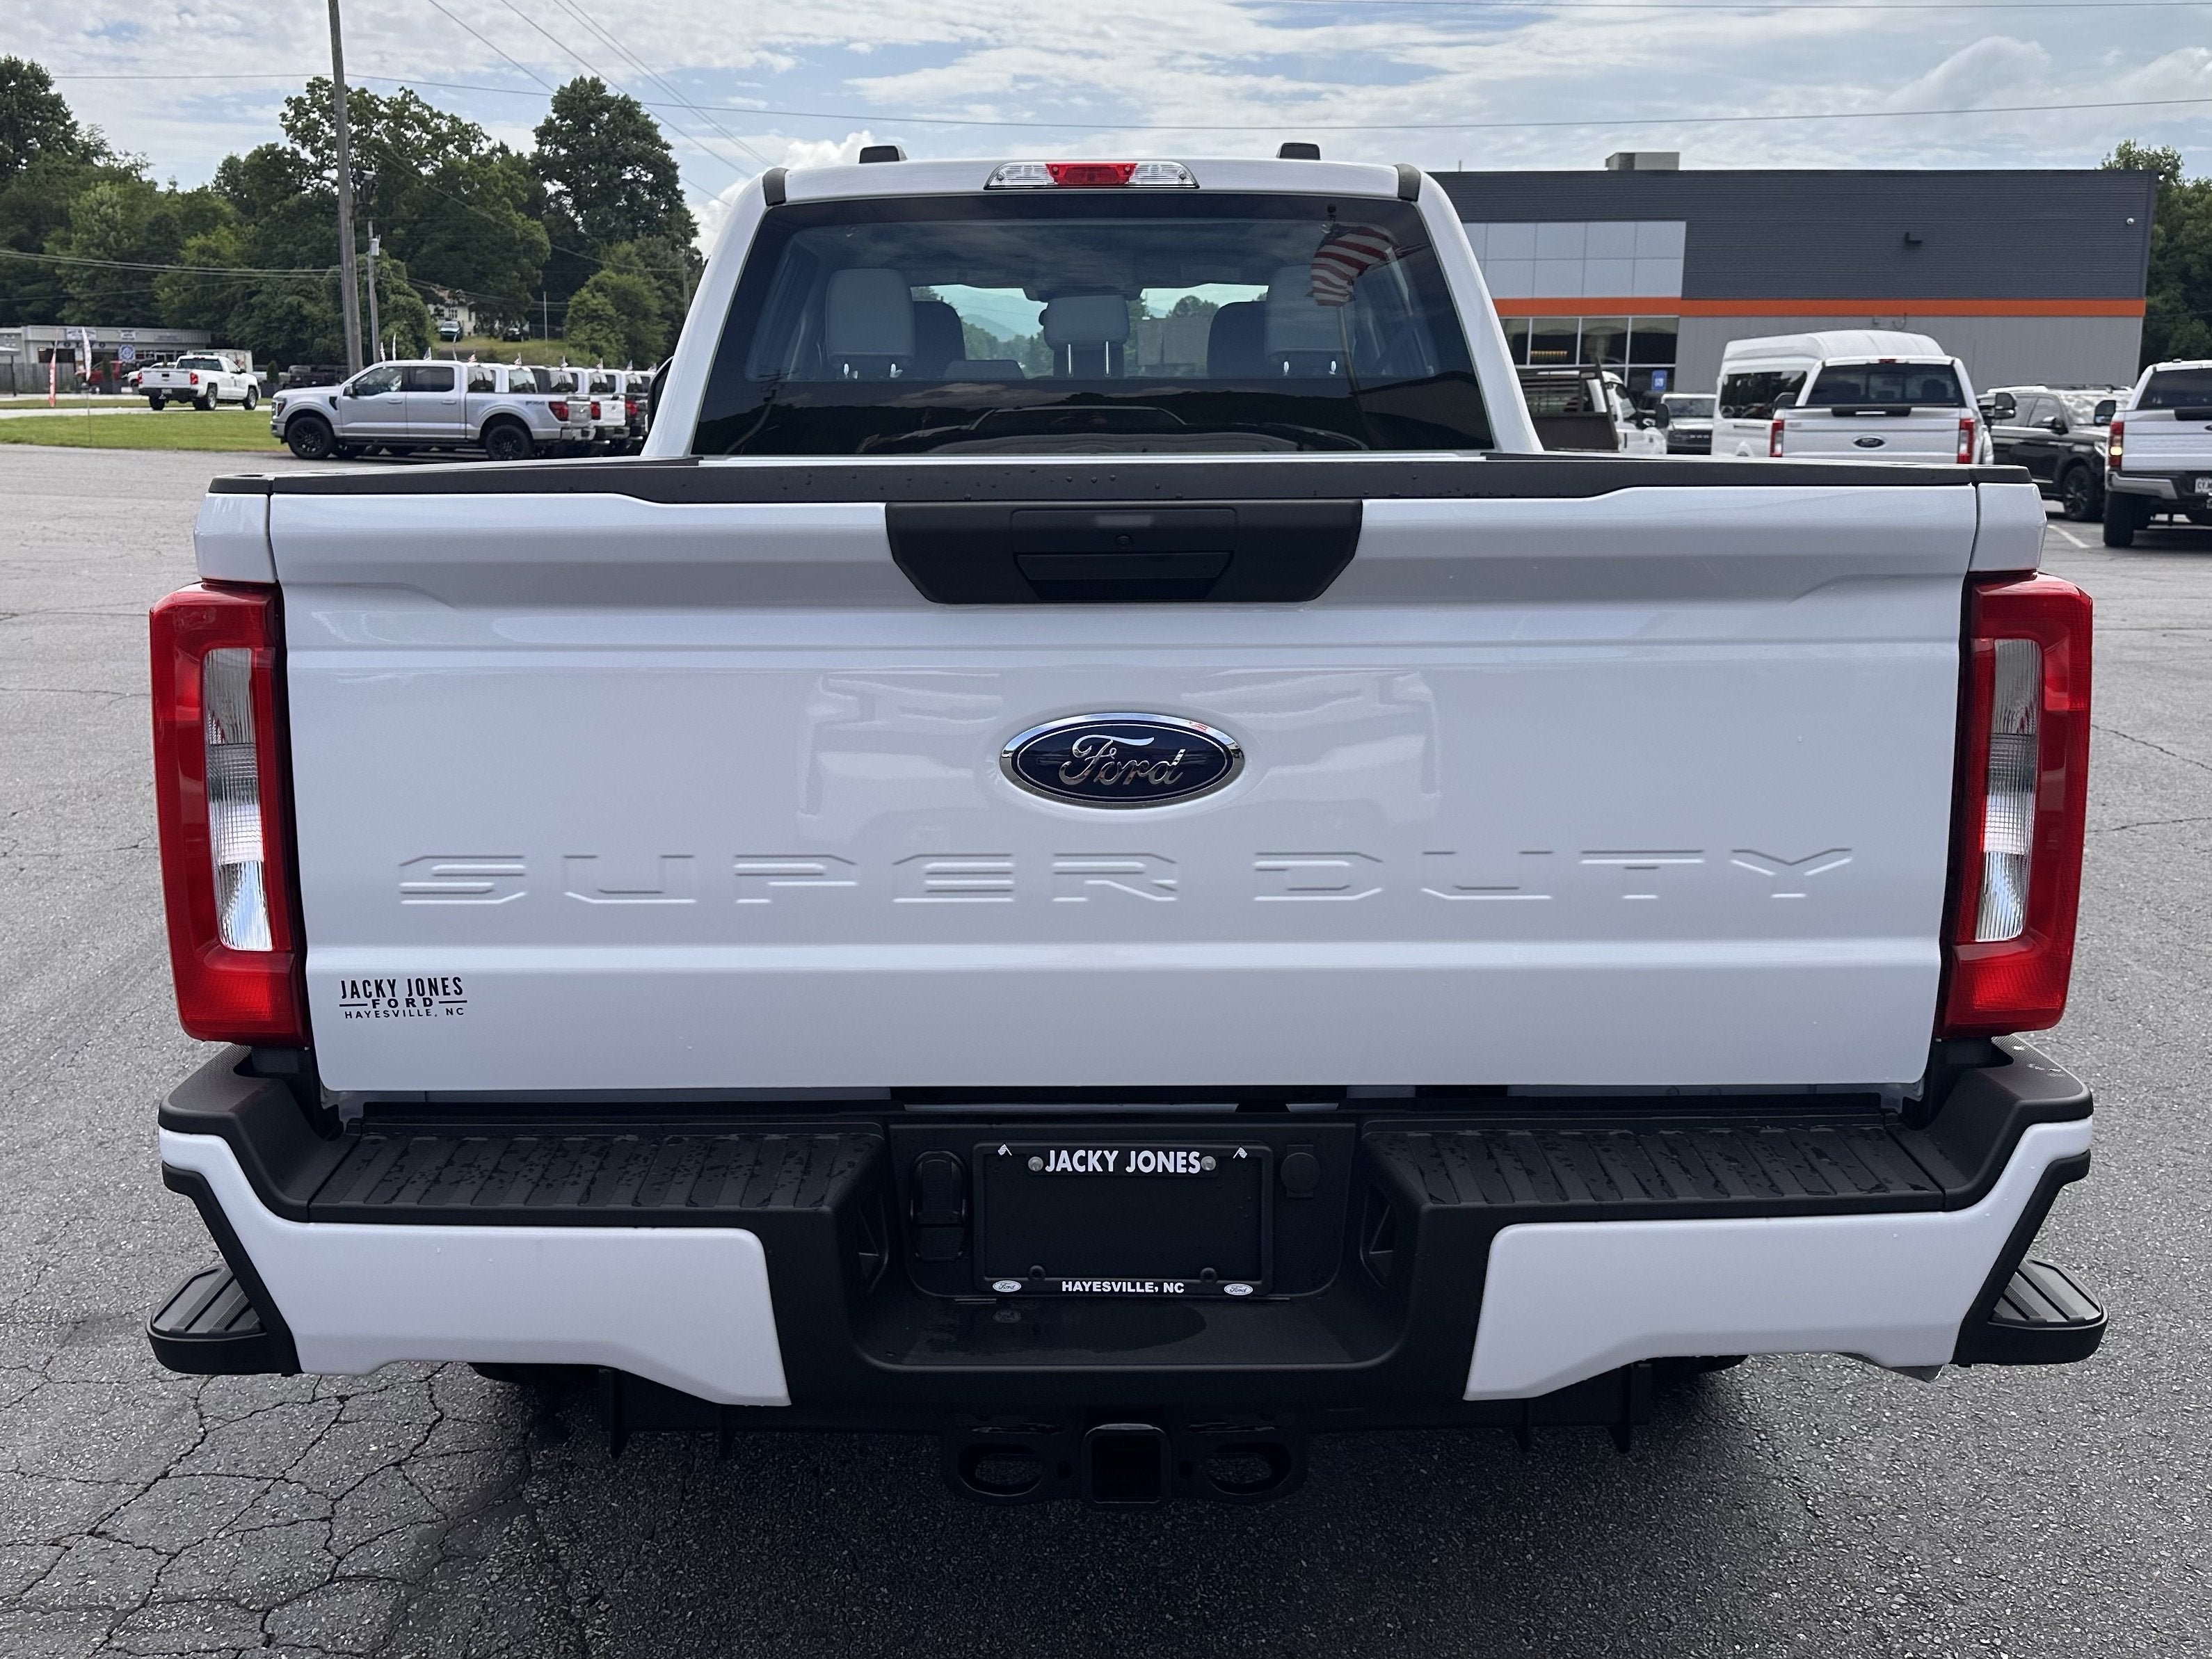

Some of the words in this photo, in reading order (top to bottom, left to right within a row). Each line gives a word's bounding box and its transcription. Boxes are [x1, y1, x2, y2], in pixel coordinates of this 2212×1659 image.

[1059, 735, 1186, 785] Ford
[399, 853, 1178, 904] SUPER
[1253, 848, 1853, 901] DUTY
[341, 979, 396, 1000] JACKY
[407, 977, 463, 997] JONES
[371, 997, 433, 1009] FORD
[446, 1007, 465, 1016] NC
[1045, 1150, 1119, 1173] JACKY
[1125, 1151, 1201, 1174] JONES
[1061, 1281, 1159, 1292] HAYESVILLE,
[1163, 1282, 1185, 1293] NC
